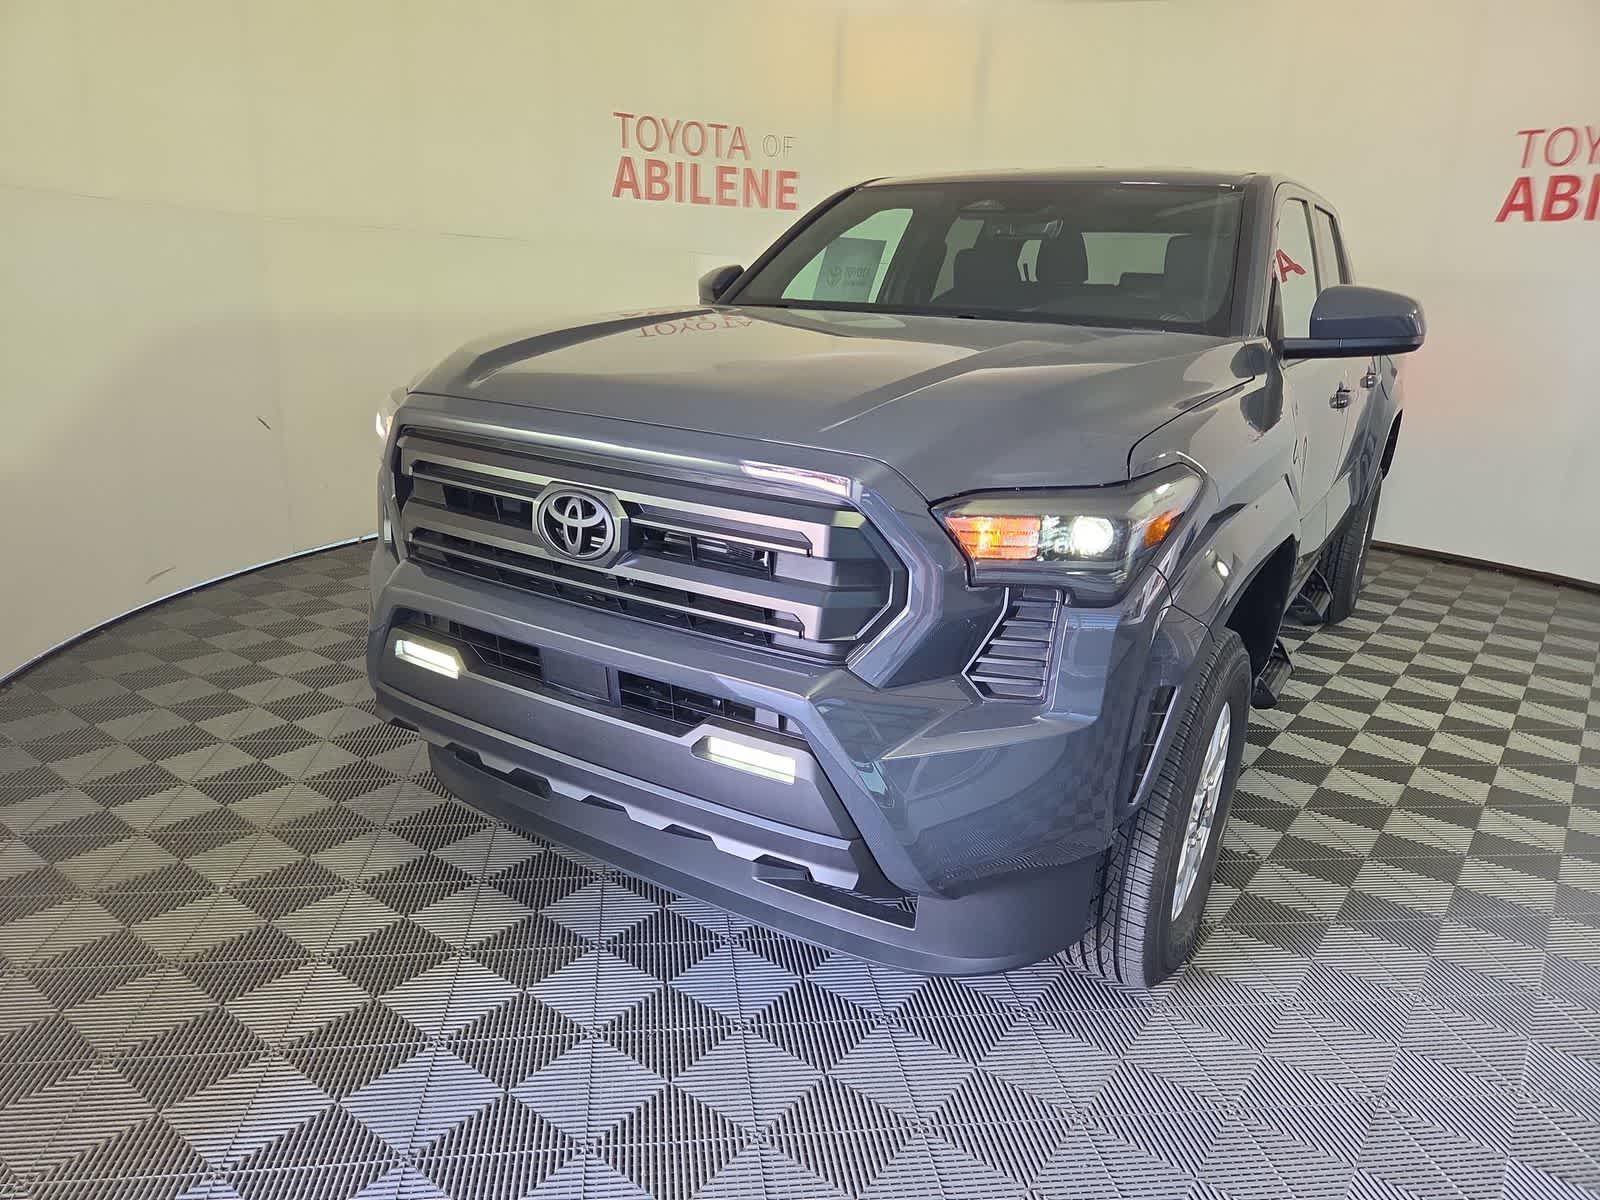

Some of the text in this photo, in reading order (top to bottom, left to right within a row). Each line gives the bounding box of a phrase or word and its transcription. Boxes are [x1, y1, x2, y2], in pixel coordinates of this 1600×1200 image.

[613, 112, 793, 160] TOYOTA OF
[612, 156, 799, 210] ABILENE
